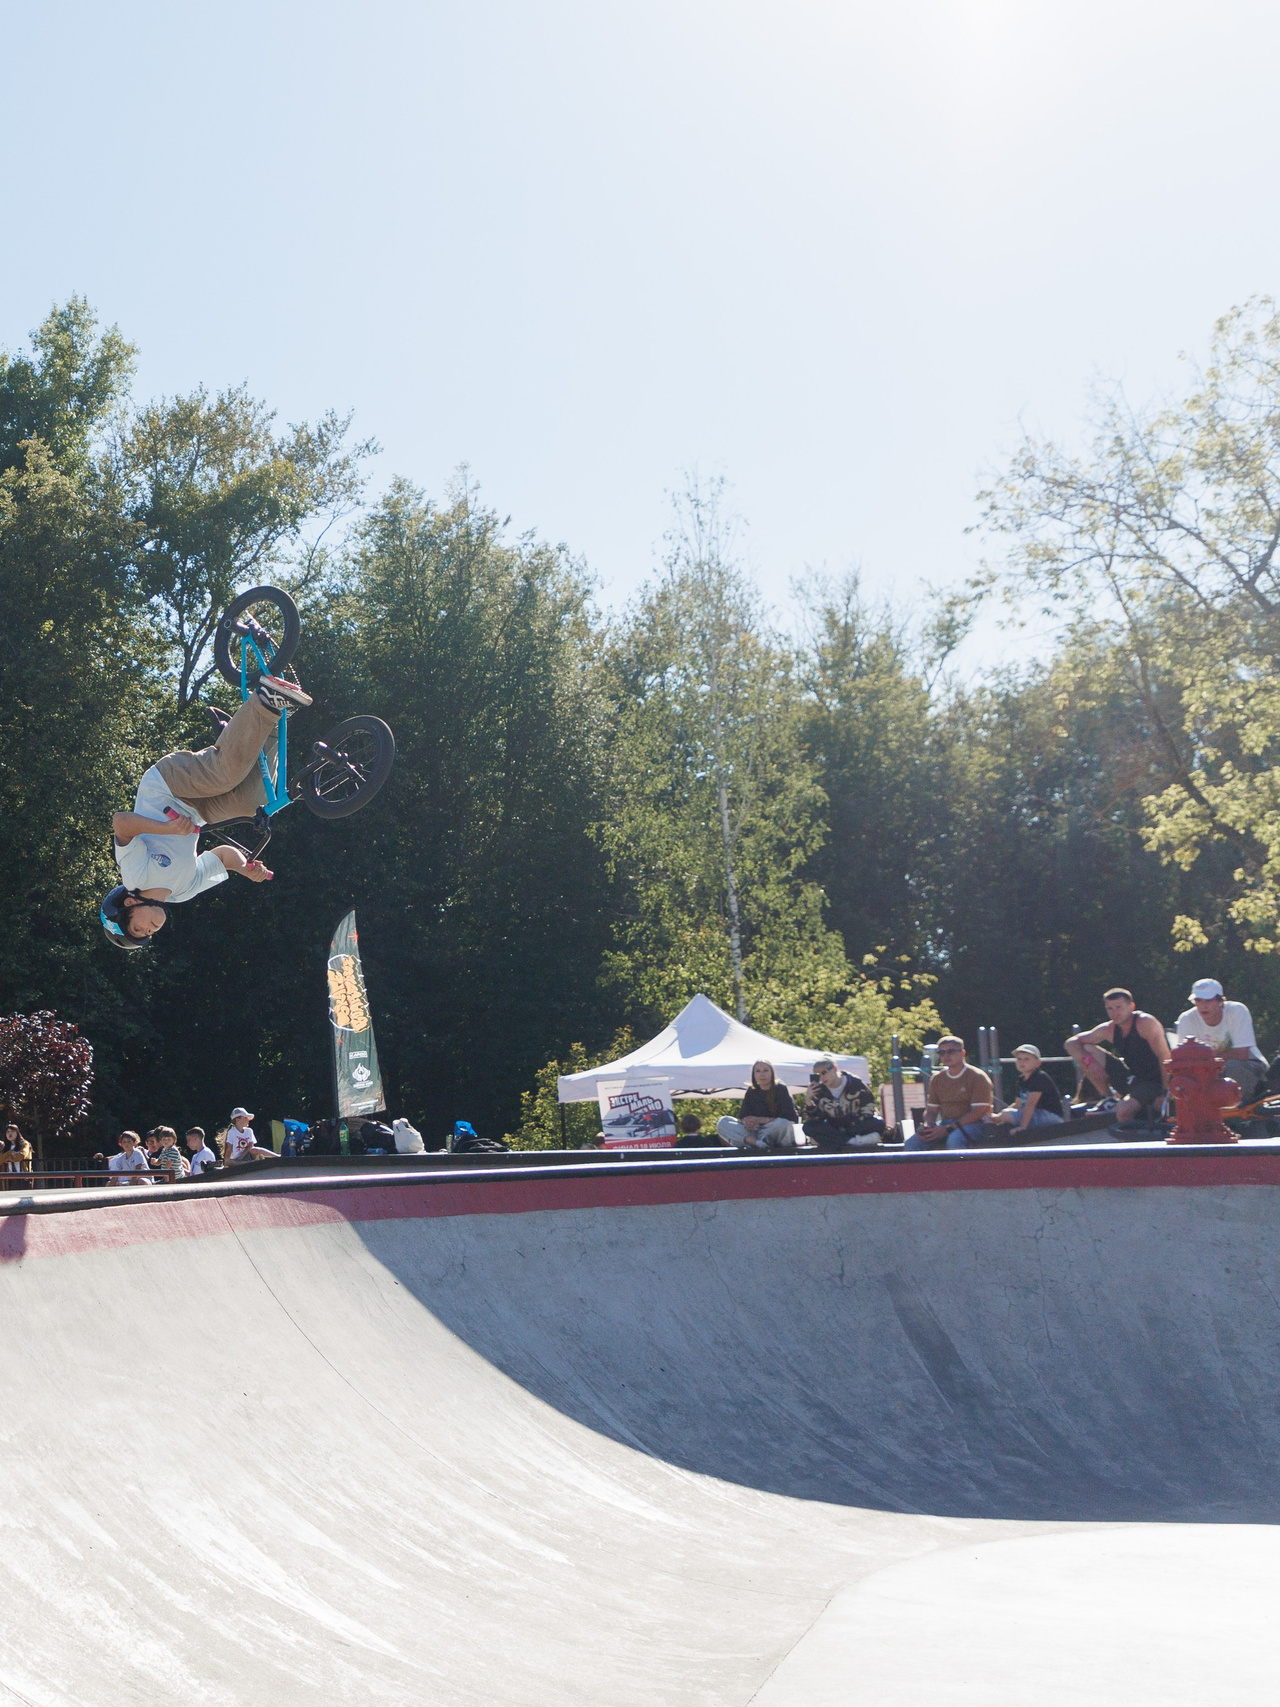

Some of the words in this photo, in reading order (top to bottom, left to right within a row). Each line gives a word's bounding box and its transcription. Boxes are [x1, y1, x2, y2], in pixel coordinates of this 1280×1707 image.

[610, 1094, 638, 1107] ЭКСТРЕ
[630, 1097, 653, 1111] МАЛЬ
[646, 1100, 662, 1111] НО
